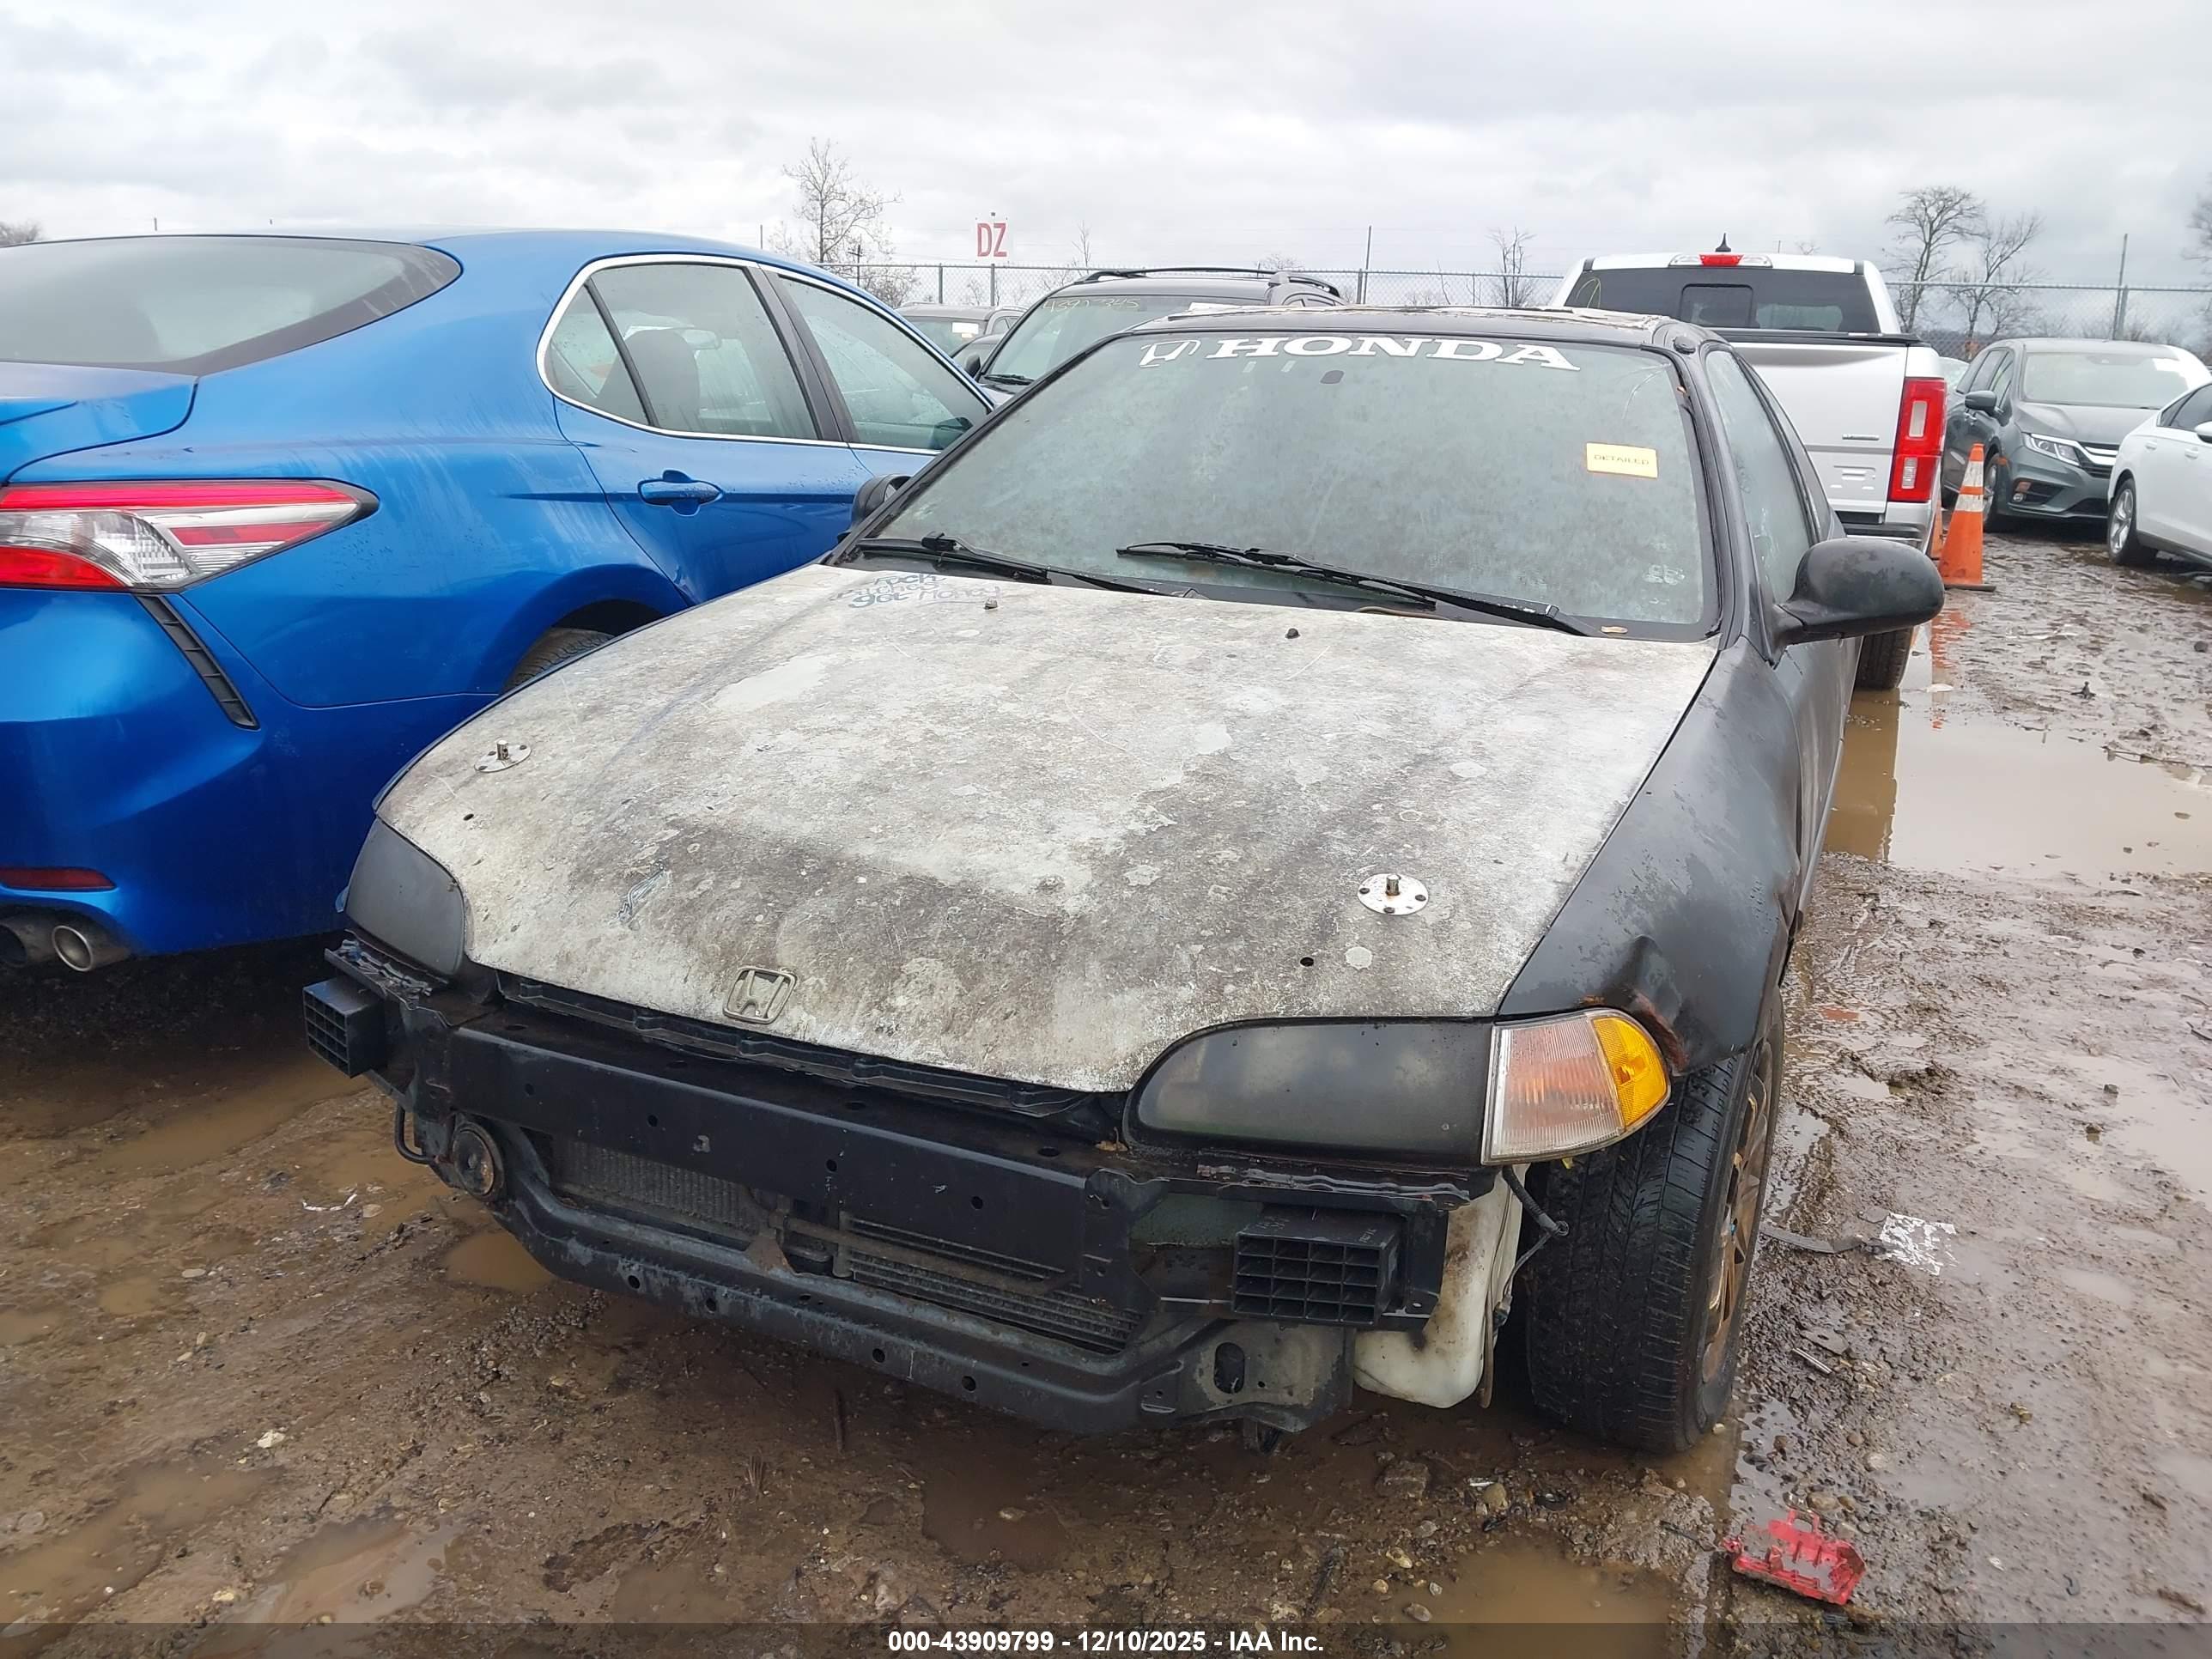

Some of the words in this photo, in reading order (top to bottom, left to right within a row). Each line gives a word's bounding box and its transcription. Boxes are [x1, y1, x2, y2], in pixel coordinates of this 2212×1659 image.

[977, 222, 1007, 258] DZ
[1204, 336, 1582, 372] HONDA
[1594, 453, 1650, 466] DETAILED
